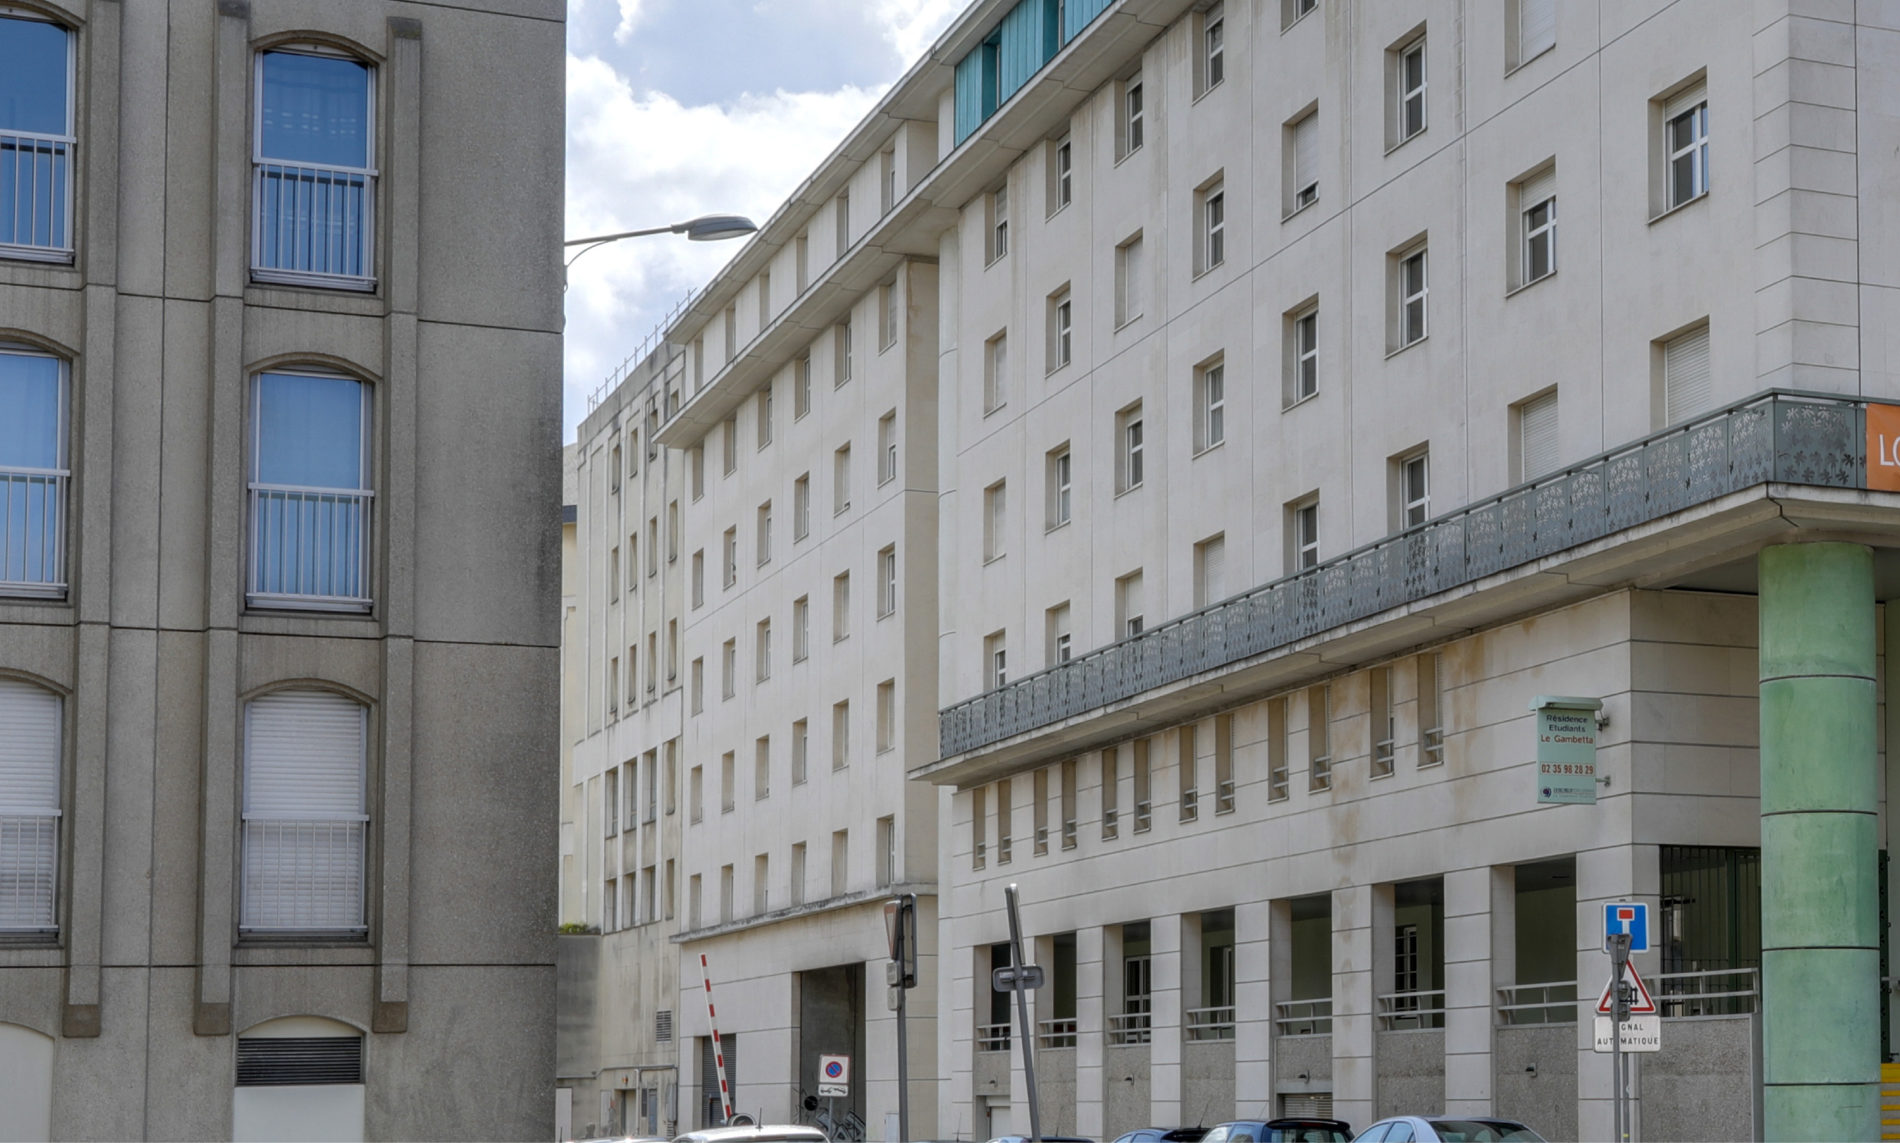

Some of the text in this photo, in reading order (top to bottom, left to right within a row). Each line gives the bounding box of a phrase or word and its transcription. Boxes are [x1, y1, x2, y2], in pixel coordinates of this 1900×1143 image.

[1546, 714, 1588, 724] Résidence
[1548, 724, 1586, 733] Etudiants
[1540, 734, 1594, 744] Le Gambetta
[1541, 764, 1594, 774] 02 35 98 28 29
[1597, 1037, 1659, 1045] AUTMATIQUE
